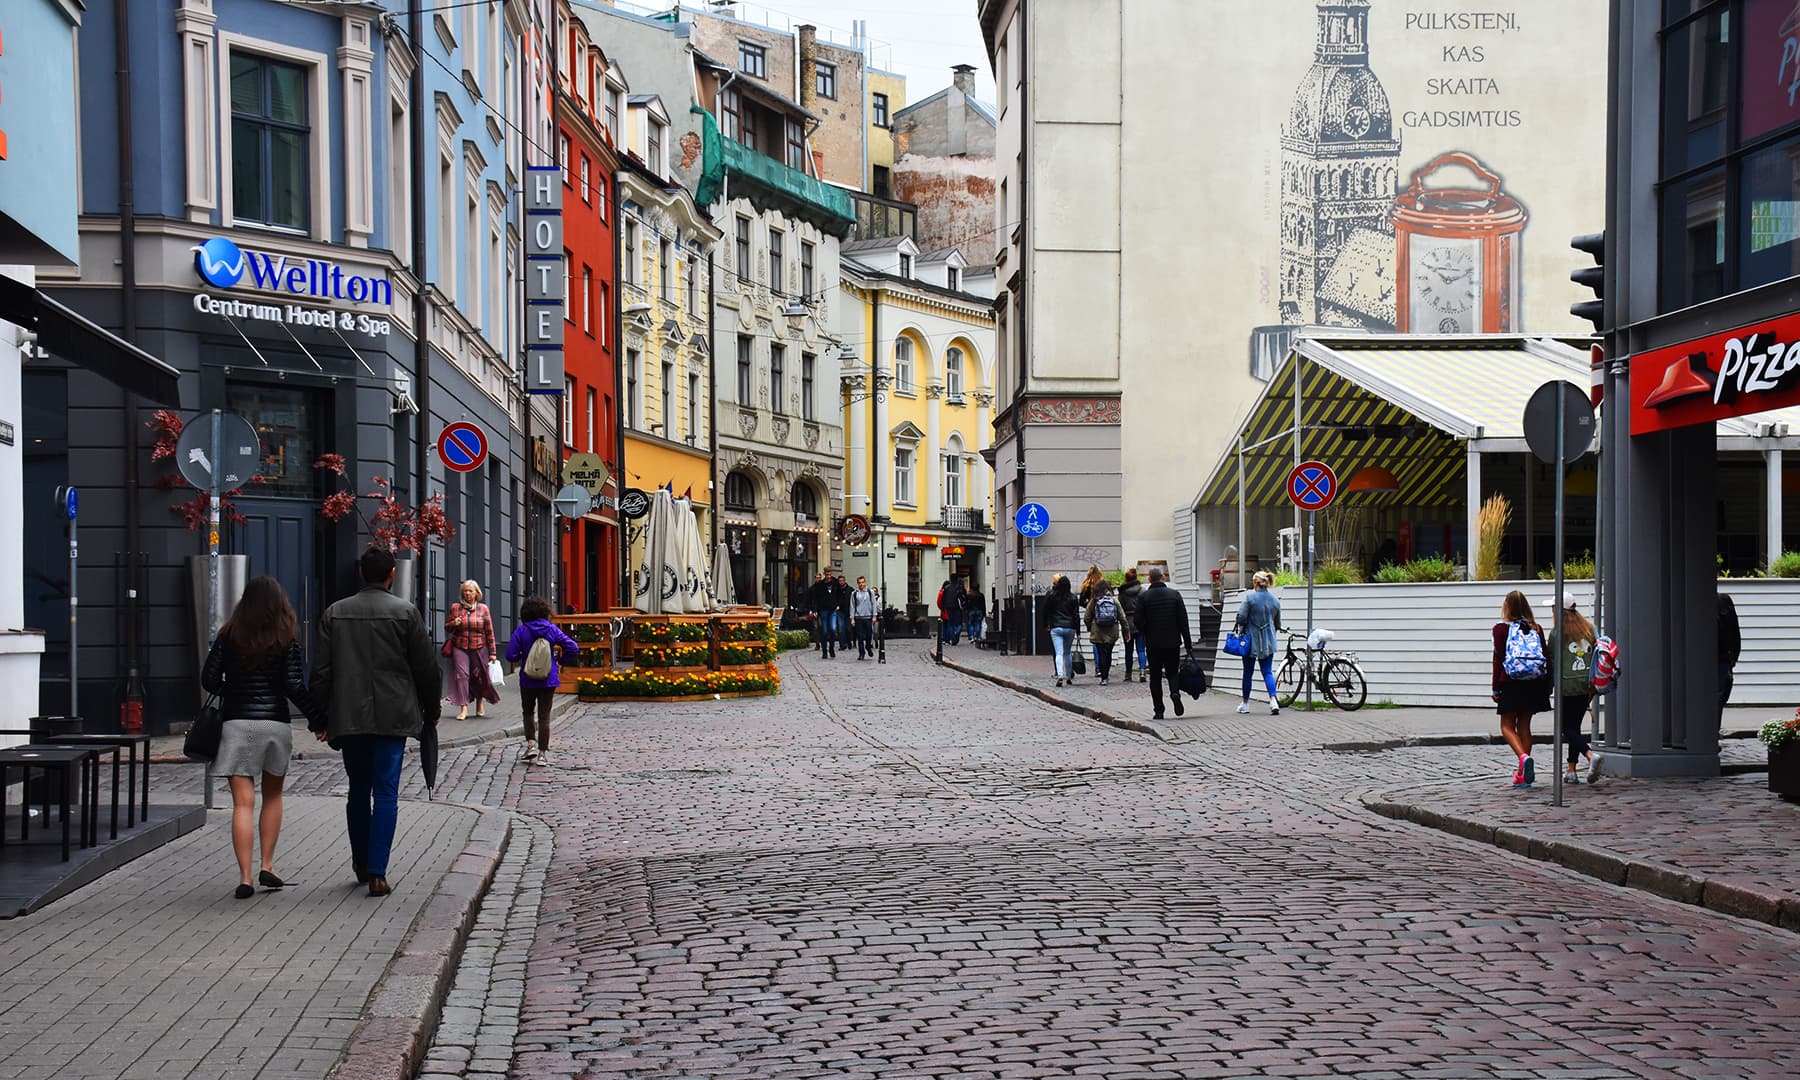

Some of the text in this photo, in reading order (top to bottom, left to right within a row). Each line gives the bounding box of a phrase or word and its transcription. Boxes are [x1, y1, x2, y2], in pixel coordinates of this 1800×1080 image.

[1405, 12, 1520, 34] PULKSTEŅI,
[1442, 45, 1485, 63] KAS
[1426, 77, 1500, 95] SKAITA
[1402, 110, 1521, 128] GADSIMTUS
[244, 250, 392, 305] Wellton
[535, 175, 553, 385] HOTEL
[193, 293, 391, 338] Centrum Hotel & Spa
[1713, 333, 1800, 405] Pizza
